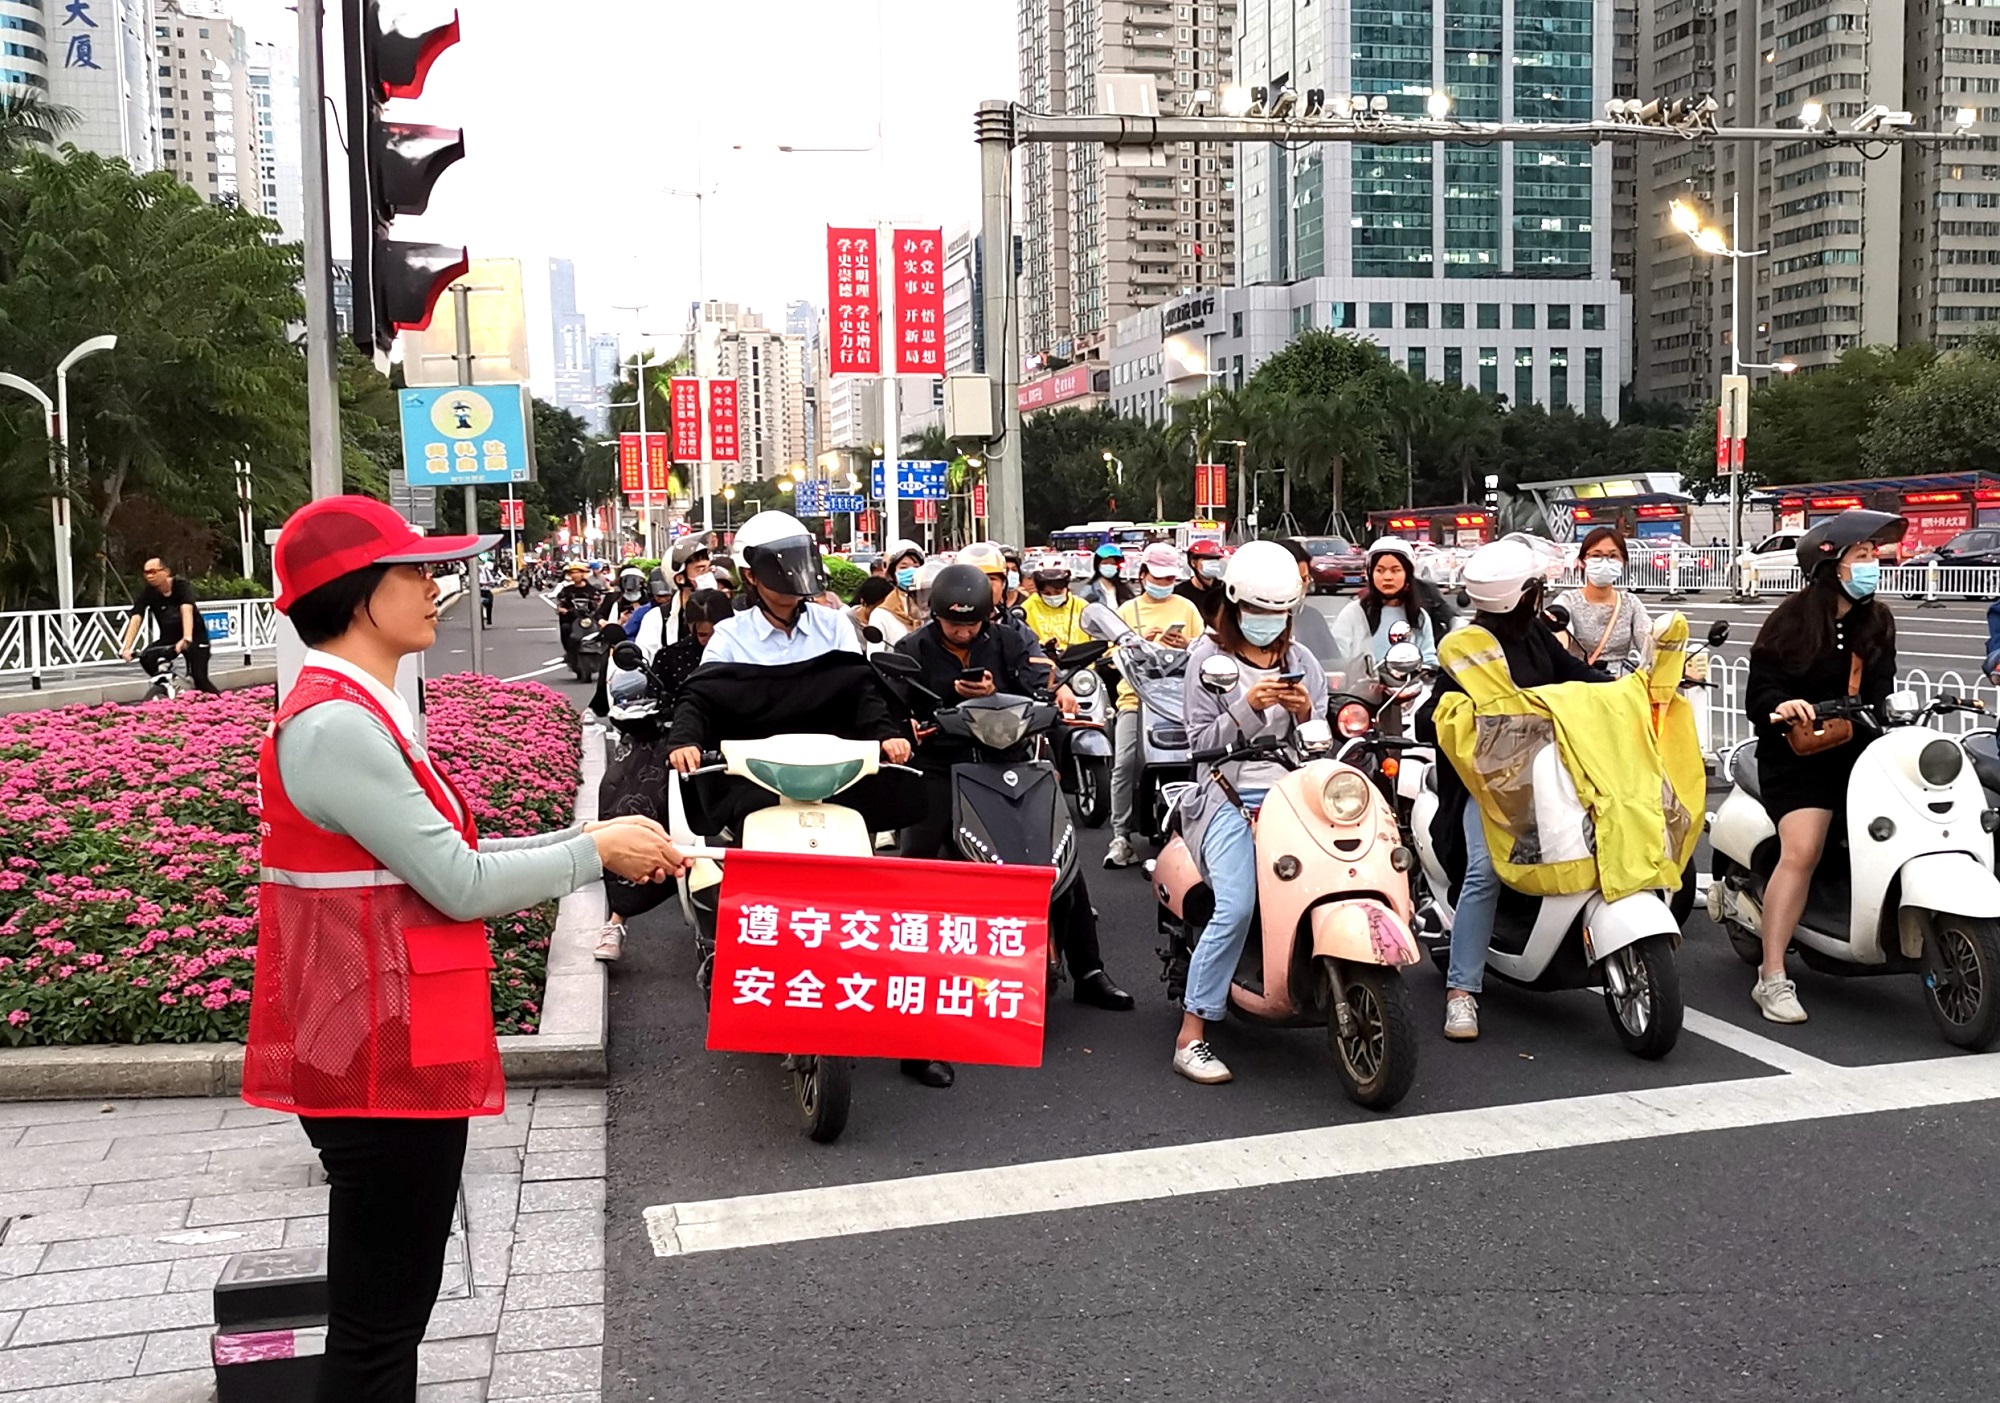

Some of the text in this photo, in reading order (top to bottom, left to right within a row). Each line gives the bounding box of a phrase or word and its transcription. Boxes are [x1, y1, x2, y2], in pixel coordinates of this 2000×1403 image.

[62, 0, 102, 69] 大厦
[837, 239, 853, 297] 学史崇德
[854, 239, 869, 298] 学史明理
[903, 239, 917, 294] 办实事
[920, 239, 935, 294] 学党史
[838, 305, 853, 363] 学史力行
[856, 305, 871, 363] 学史增信
[905, 309, 919, 363] 开新局
[921, 309, 936, 363] 悟思想
[737, 904, 1027, 957] 遵守交通规范
[732, 966, 1025, 1019] 安全文明出行
